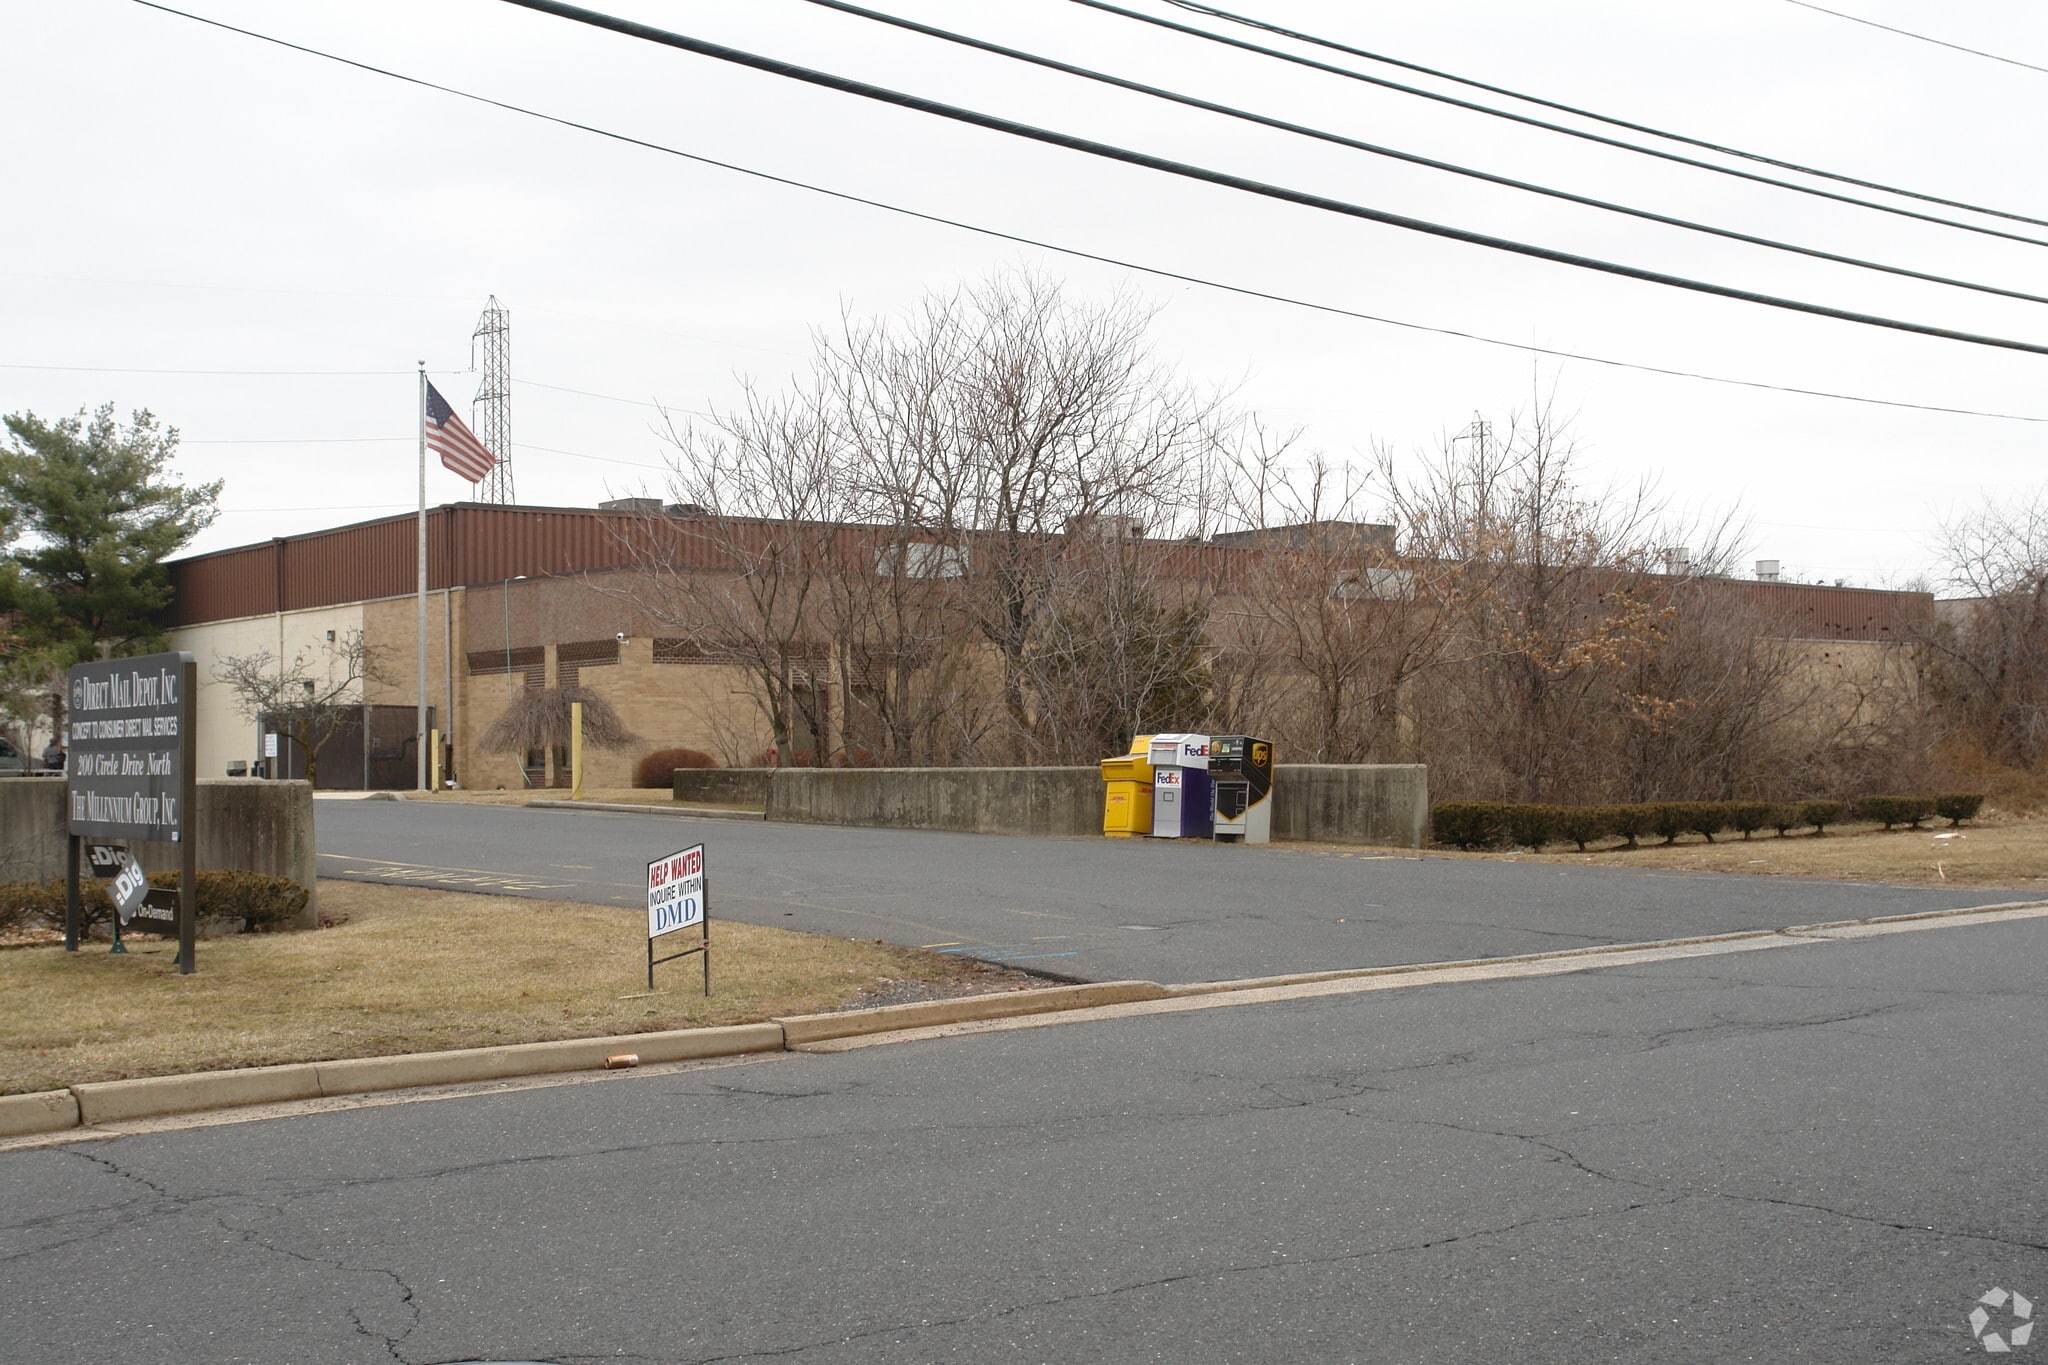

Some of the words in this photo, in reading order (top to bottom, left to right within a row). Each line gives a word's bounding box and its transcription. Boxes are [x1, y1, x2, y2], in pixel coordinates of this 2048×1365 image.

[83, 677, 109, 710] DIRECT
[110, 673, 131, 708] MAIL
[132, 671, 159, 711] DEPOT,
[161, 668, 177, 704] INC.
[72, 721, 91, 740] CONCEPT
[92, 721, 98, 739] TO
[99, 719, 124, 739] CONSUMER
[125, 718, 141, 738] DIRECT
[142, 717, 153, 737] MAIL
[153, 715, 178, 736] SERVICES
[77, 754, 93, 776] 200
[95, 753, 119, 776] Circle
[121, 753, 144, 776] Drive
[146, 752, 171, 776] North
[1185, 744, 1208, 757] FedE
[1157, 772, 1180, 784] FedEx
[72, 790, 86, 821] THE
[86, 790, 132, 824] MILLENNIUM
[133, 791, 160, 830] GROUP,
[161, 792, 177, 825] INC.
[650, 862, 668, 889] HELP
[671, 850, 701, 881] WANTED
[650, 884, 676, 907] INQUIRE
[678, 876, 702, 897] WITHIN
[138, 903, 174, 921] On-Demand
[656, 897, 697, 931] DMD
